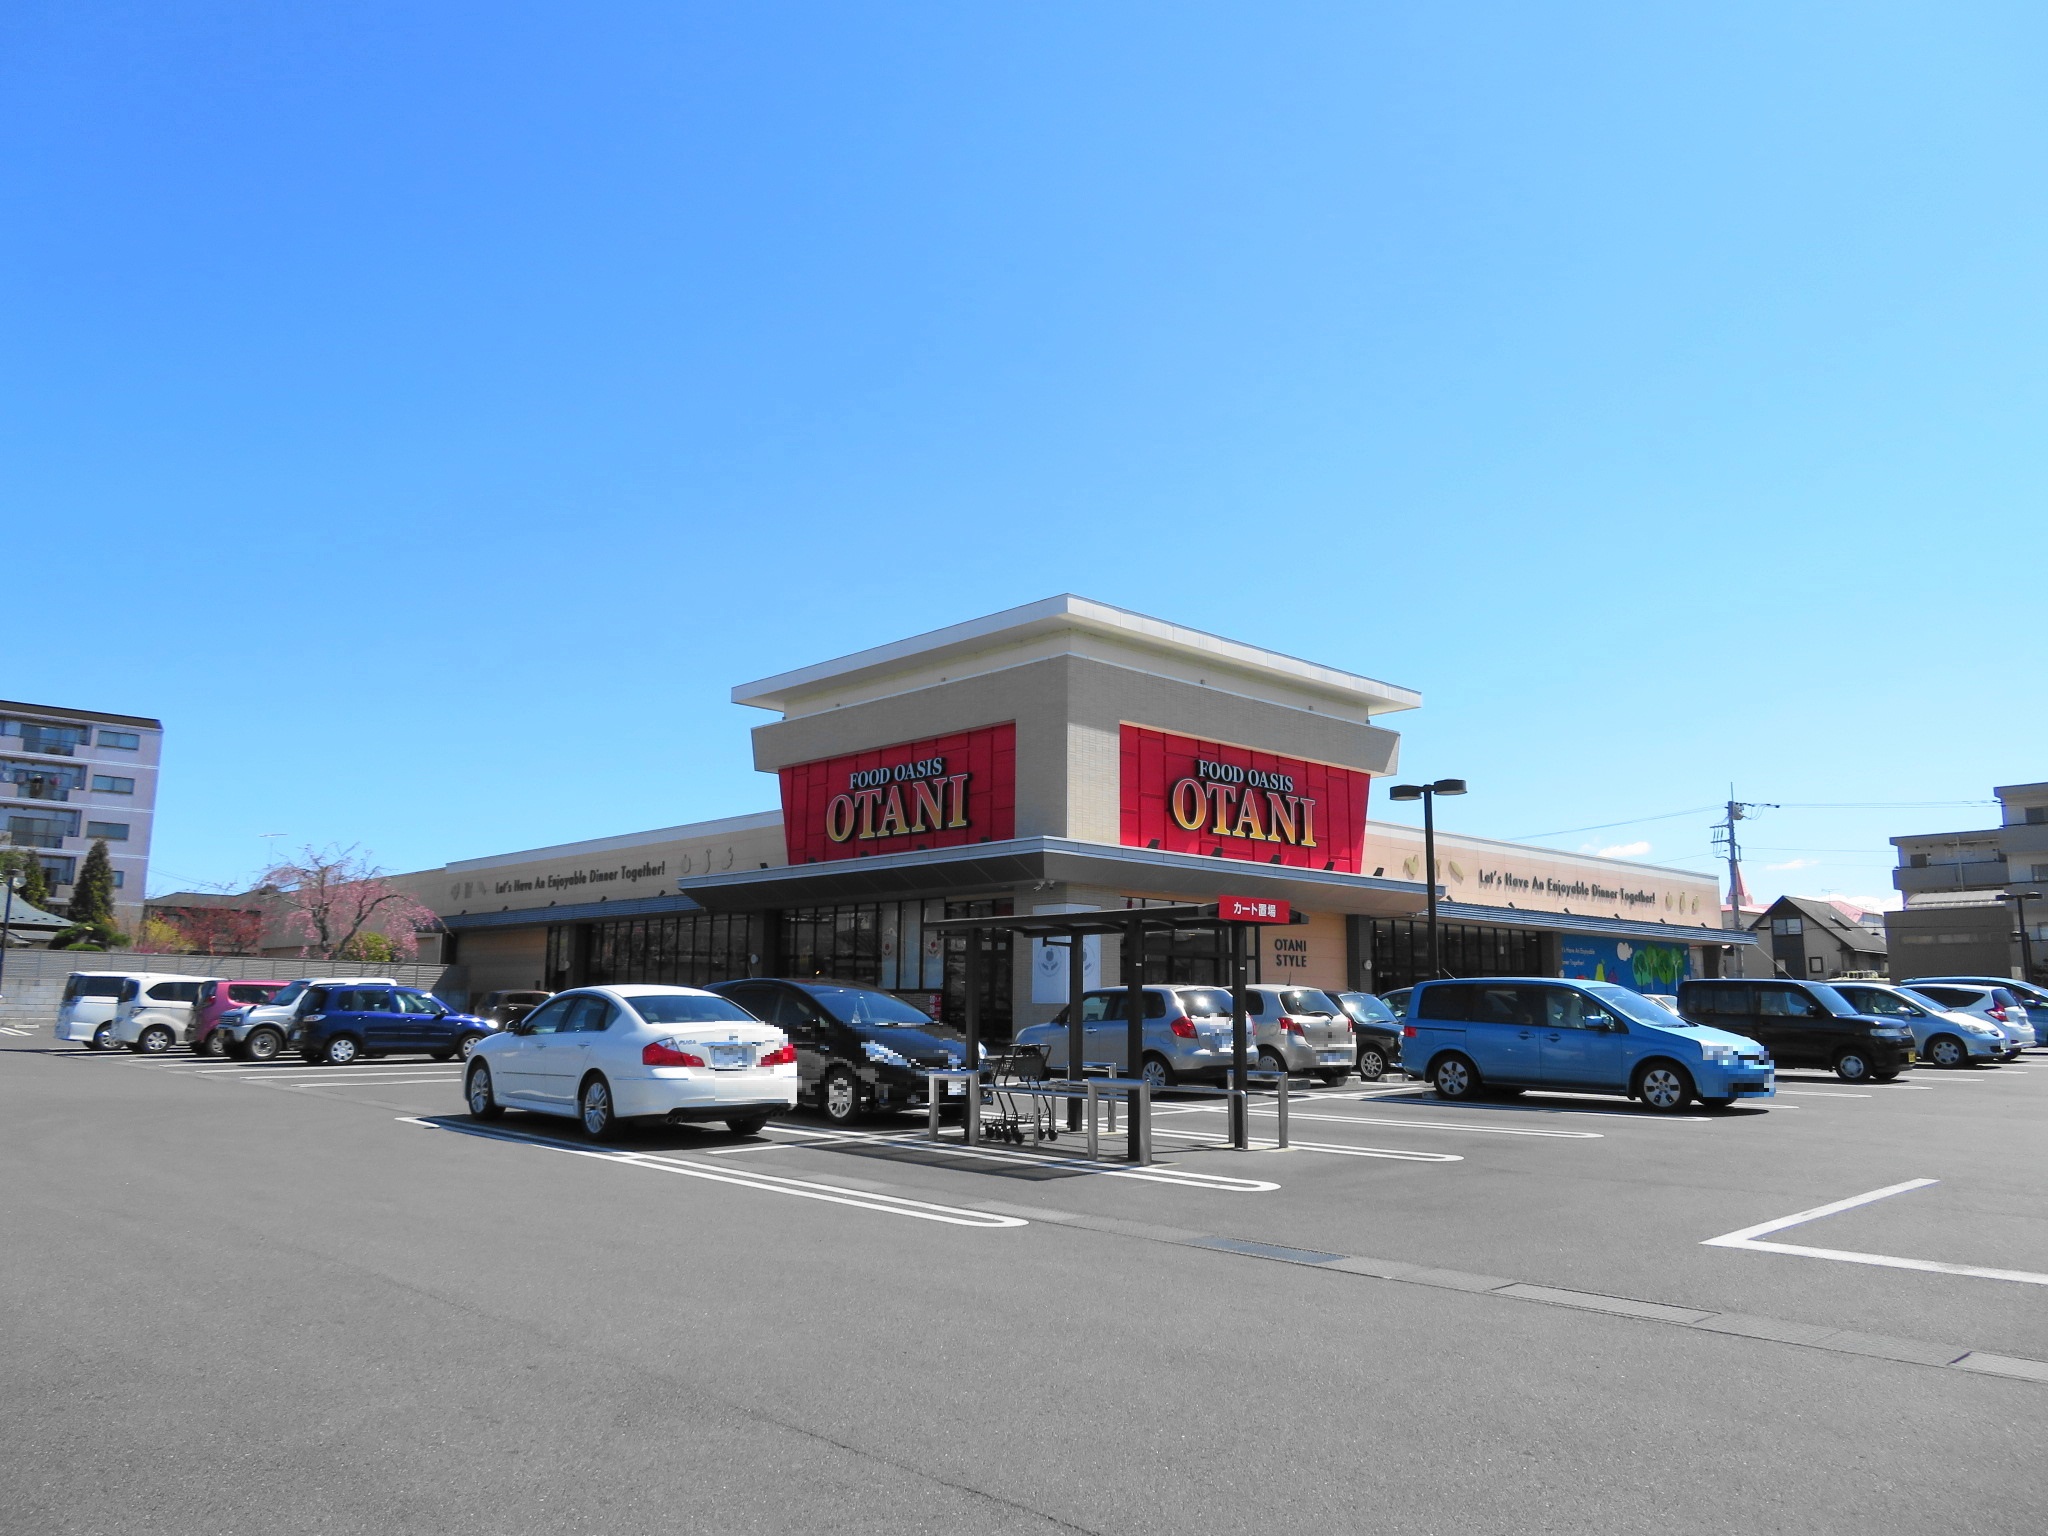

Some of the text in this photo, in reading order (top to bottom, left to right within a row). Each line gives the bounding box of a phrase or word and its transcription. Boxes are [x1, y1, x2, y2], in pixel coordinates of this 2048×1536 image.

[849, 757, 943, 789] FOOD OASIS
[1198, 759, 1295, 793] FOOD OASIS
[826, 774, 968, 842] OTANI
[1172, 778, 1317, 848] OTANI
[496, 860, 665, 894] Let's Have An Enjoyable Dinner Together!
[1479, 869, 1655, 904] Let's Have An Enjoyable Dinner Together!
[1233, 901, 1276, 918] カート置場
[1274, 938, 1307, 952] OTANI
[1276, 953, 1307, 968] STYLE
